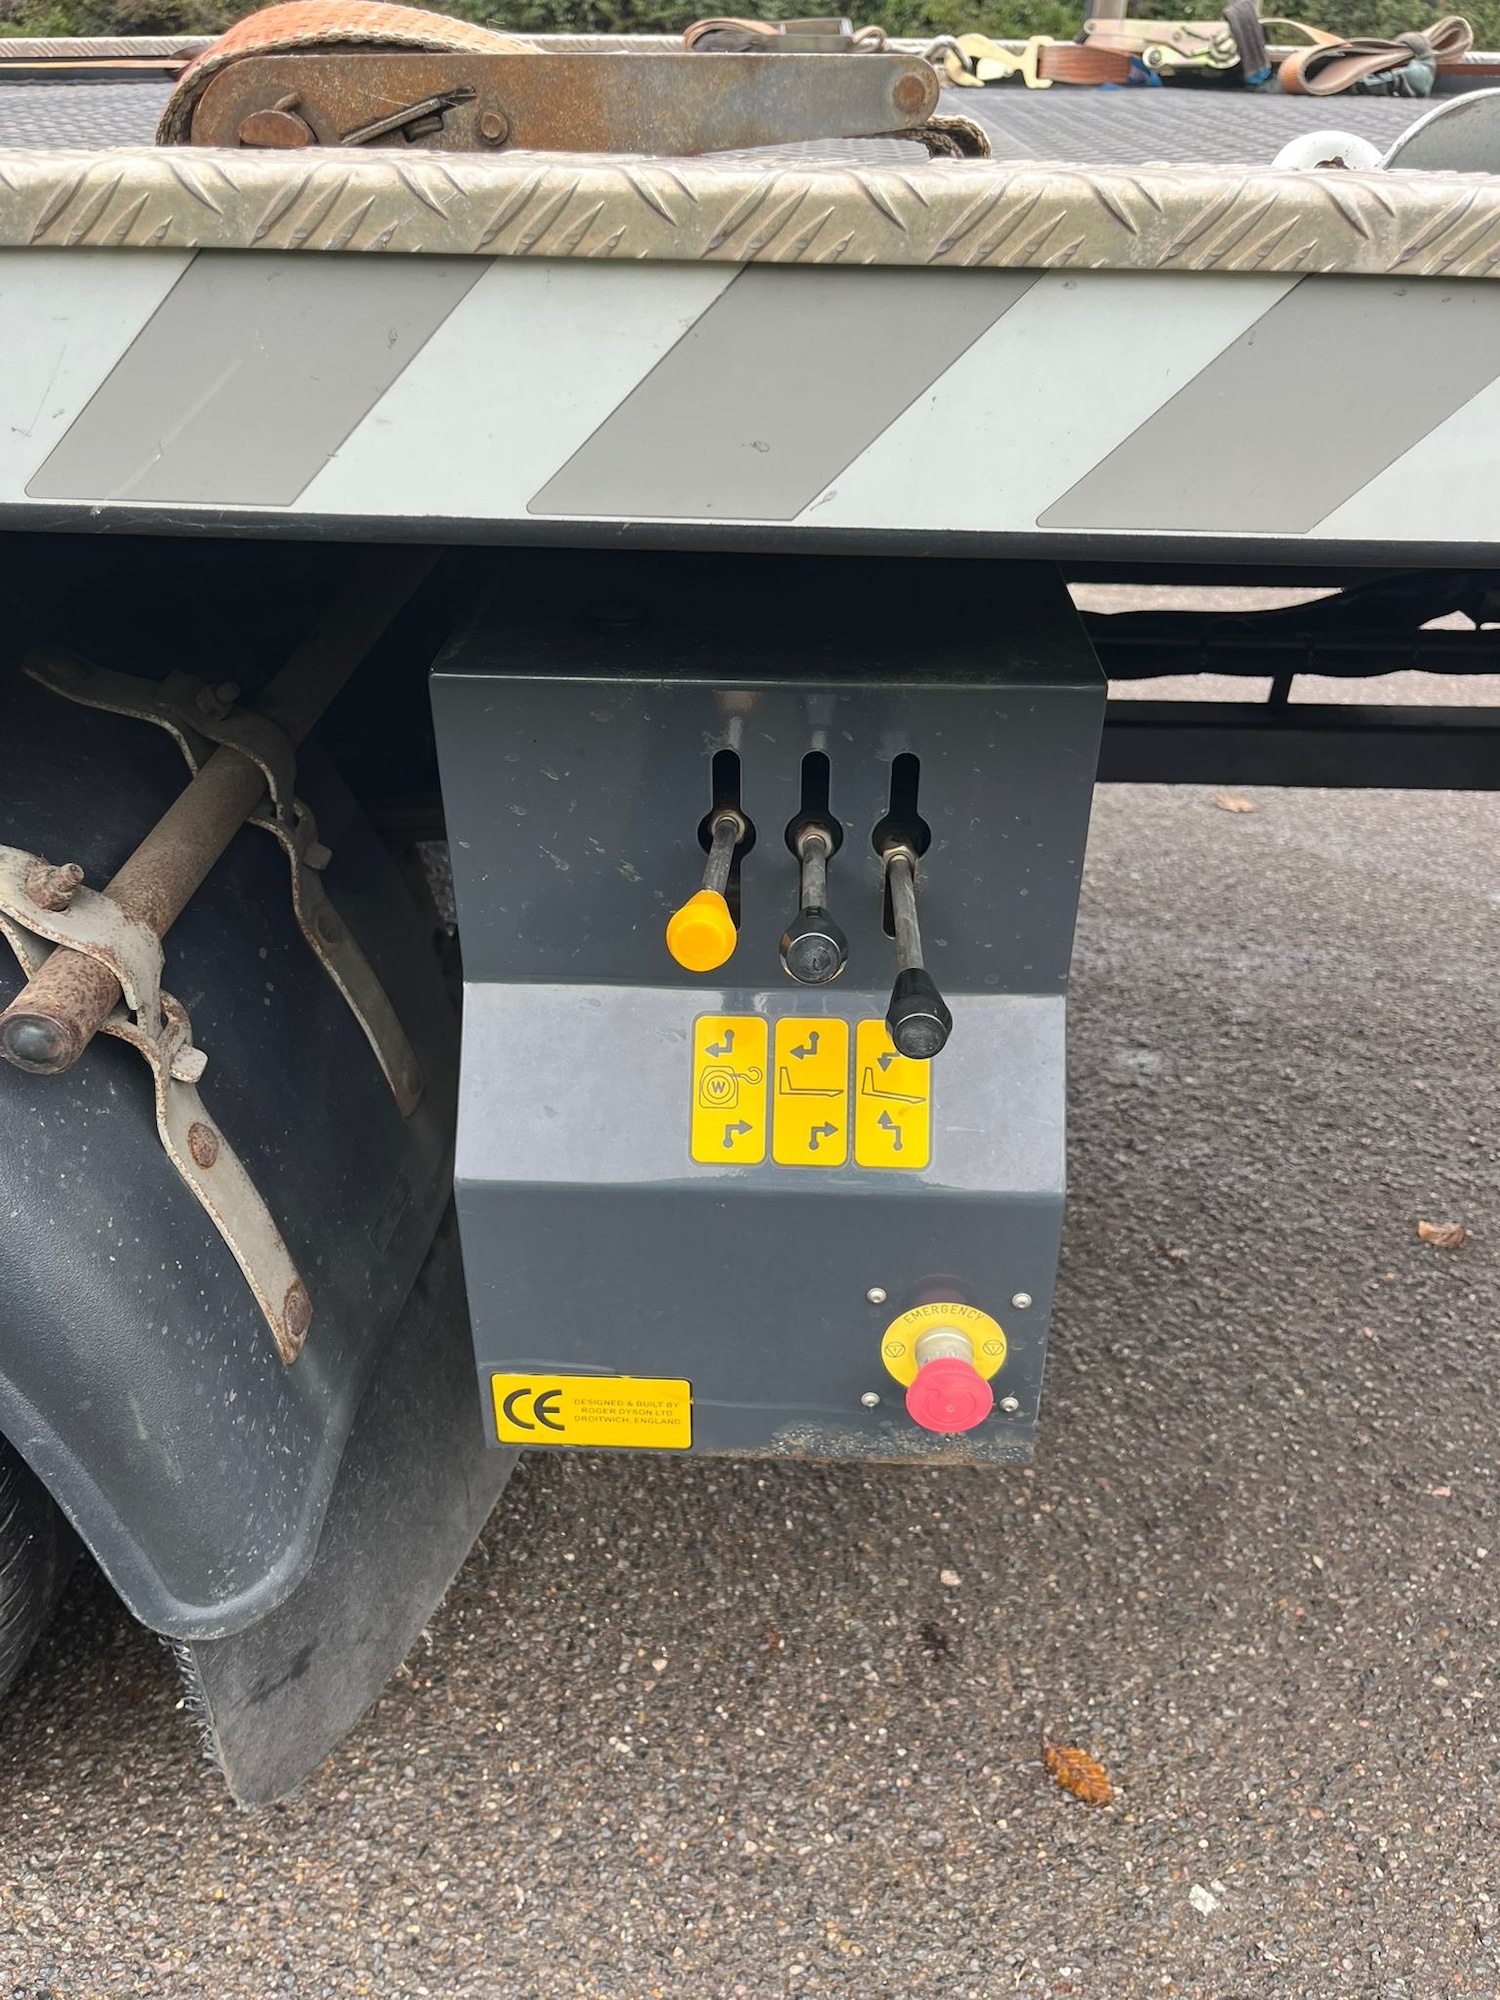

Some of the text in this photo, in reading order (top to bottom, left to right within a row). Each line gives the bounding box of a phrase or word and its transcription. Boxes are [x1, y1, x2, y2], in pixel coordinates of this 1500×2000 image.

[711, 1082, 726, 1093] W
[903, 1304, 985, 1324] EMERGENCY
[574, 1398, 624, 1407] DESIGNED
[503, 1388, 565, 1431] CE
[619, 1408, 652, 1416] DYSON
[634, 1417, 681, 1425] ENGLAND
